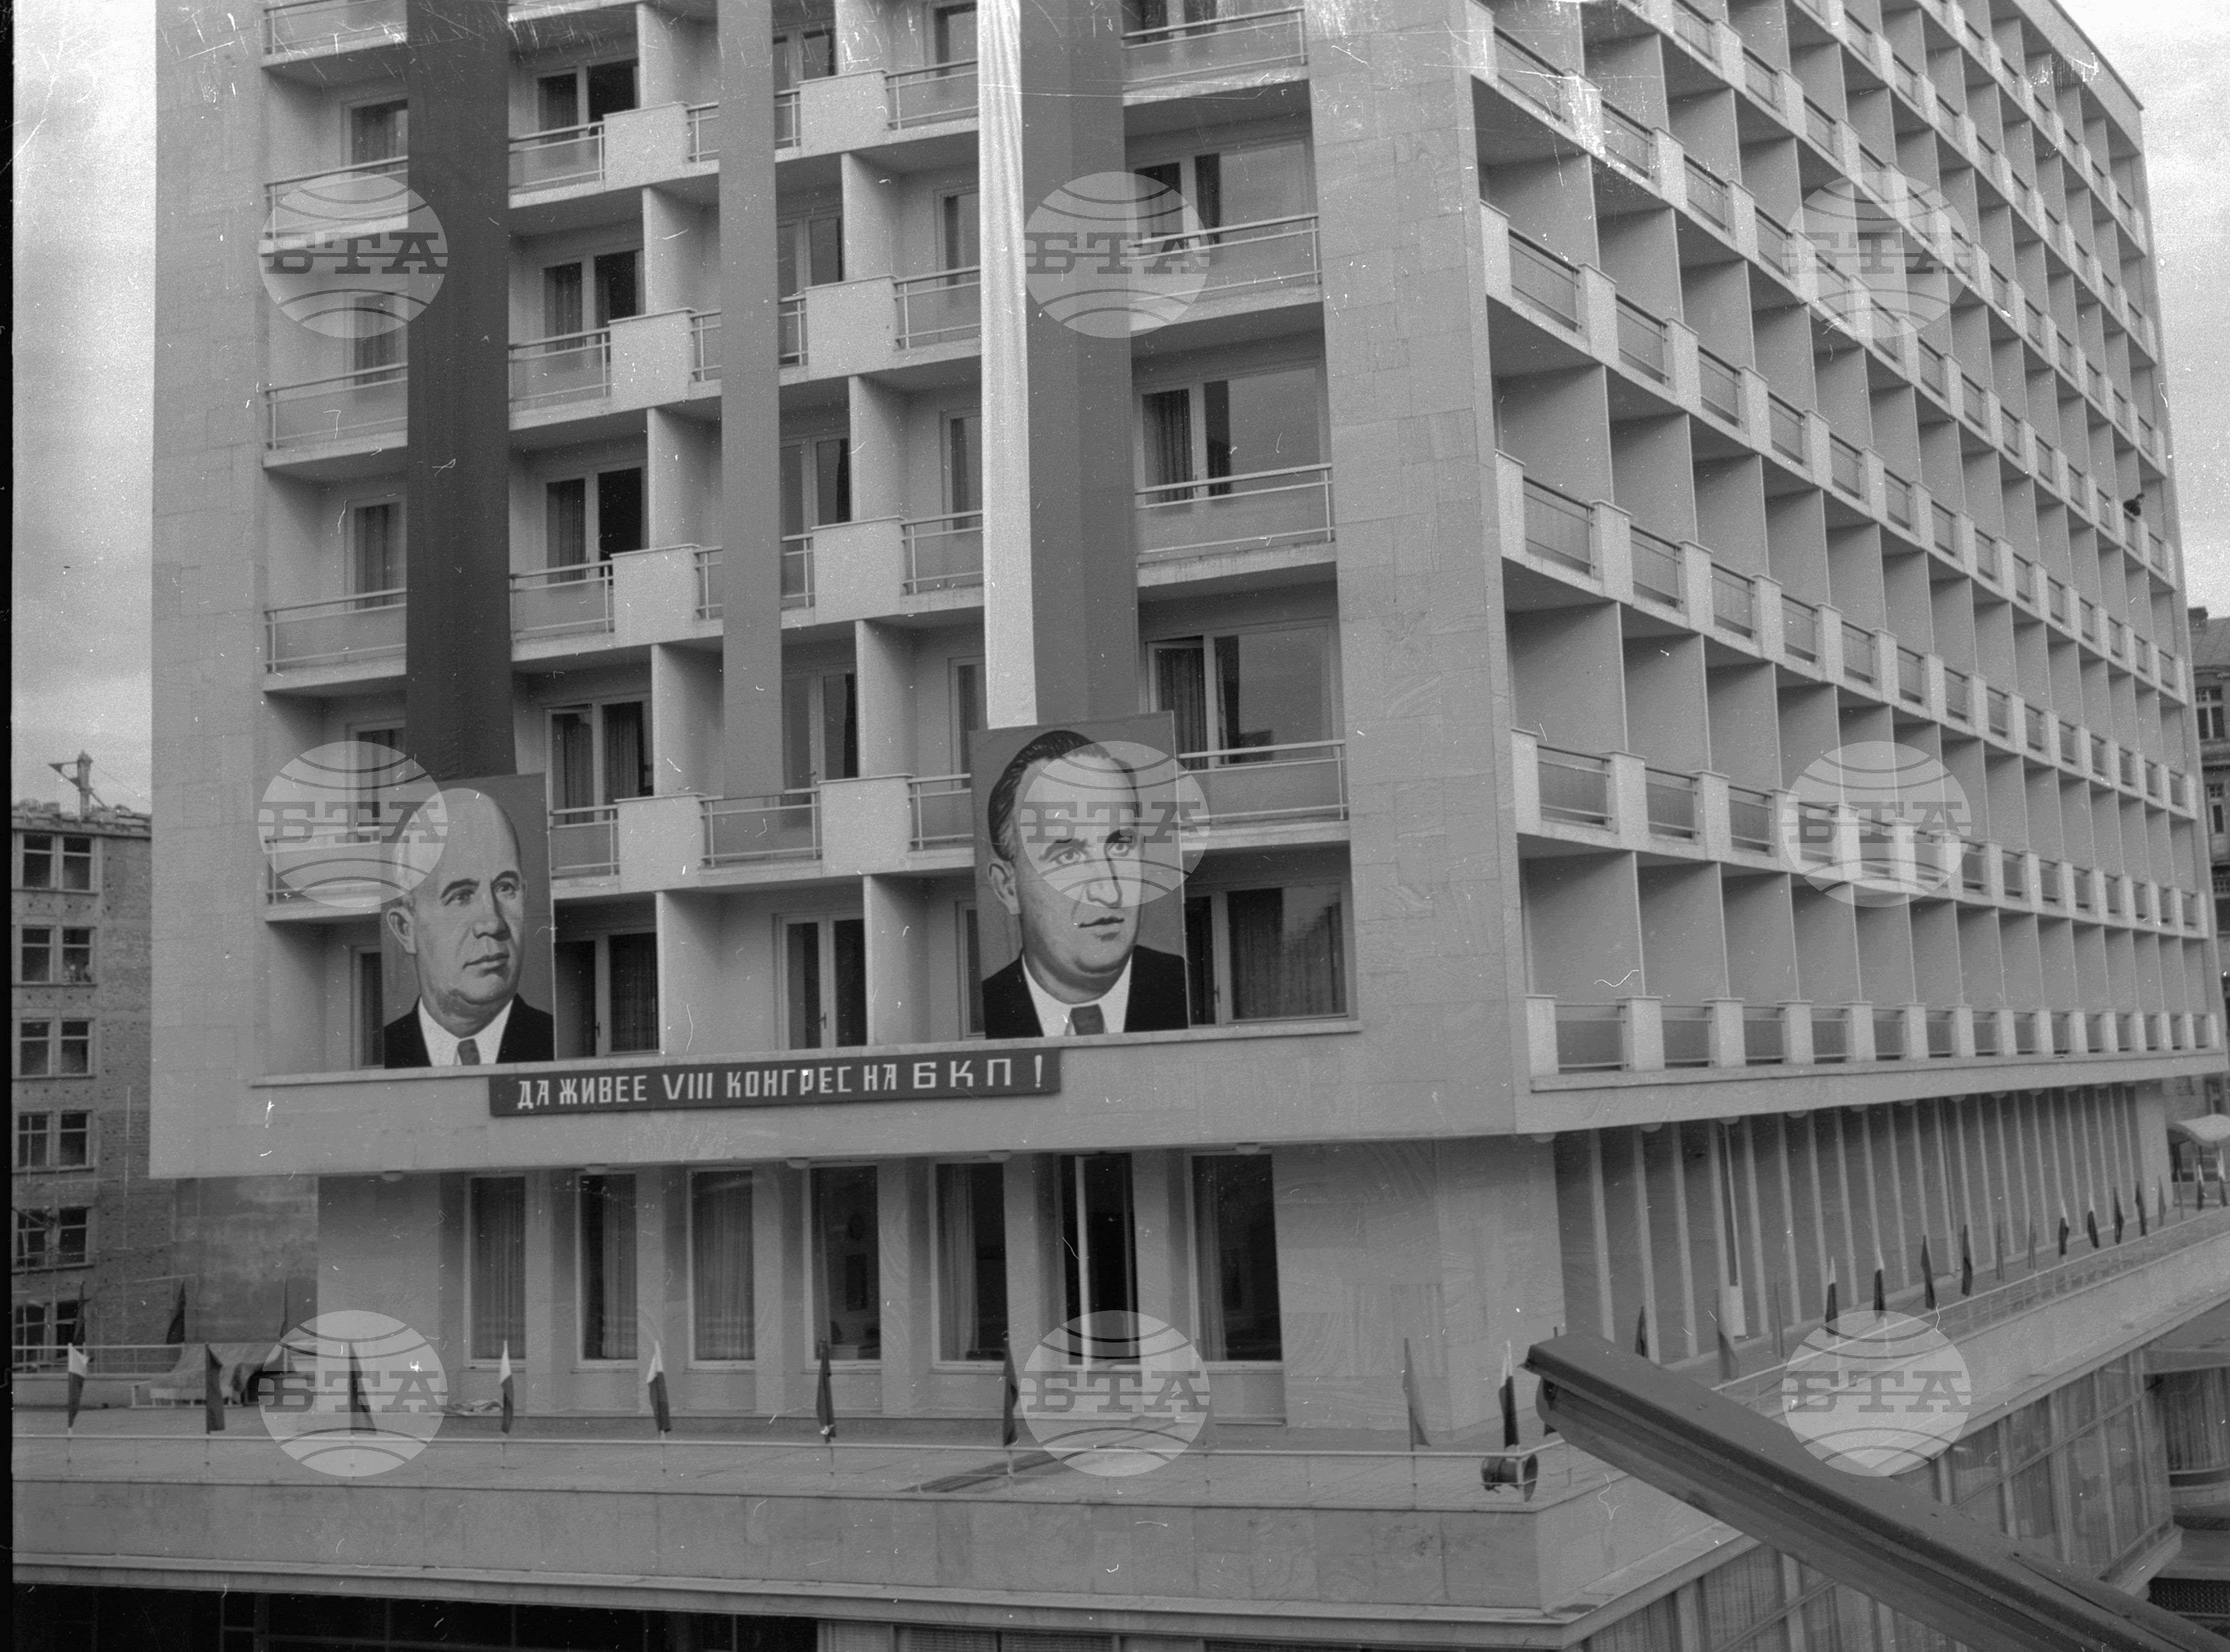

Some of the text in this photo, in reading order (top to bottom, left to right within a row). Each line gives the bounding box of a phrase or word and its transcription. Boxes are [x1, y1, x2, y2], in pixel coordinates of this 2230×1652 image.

[517, 1079, 550, 1110] ДА
[559, 1075, 648, 1104] ЖИВЕЕ
[662, 1072, 713, 1100] VIII
[726, 1065, 852, 1098] КОНГРЕС
[864, 1063, 897, 1092] НА
